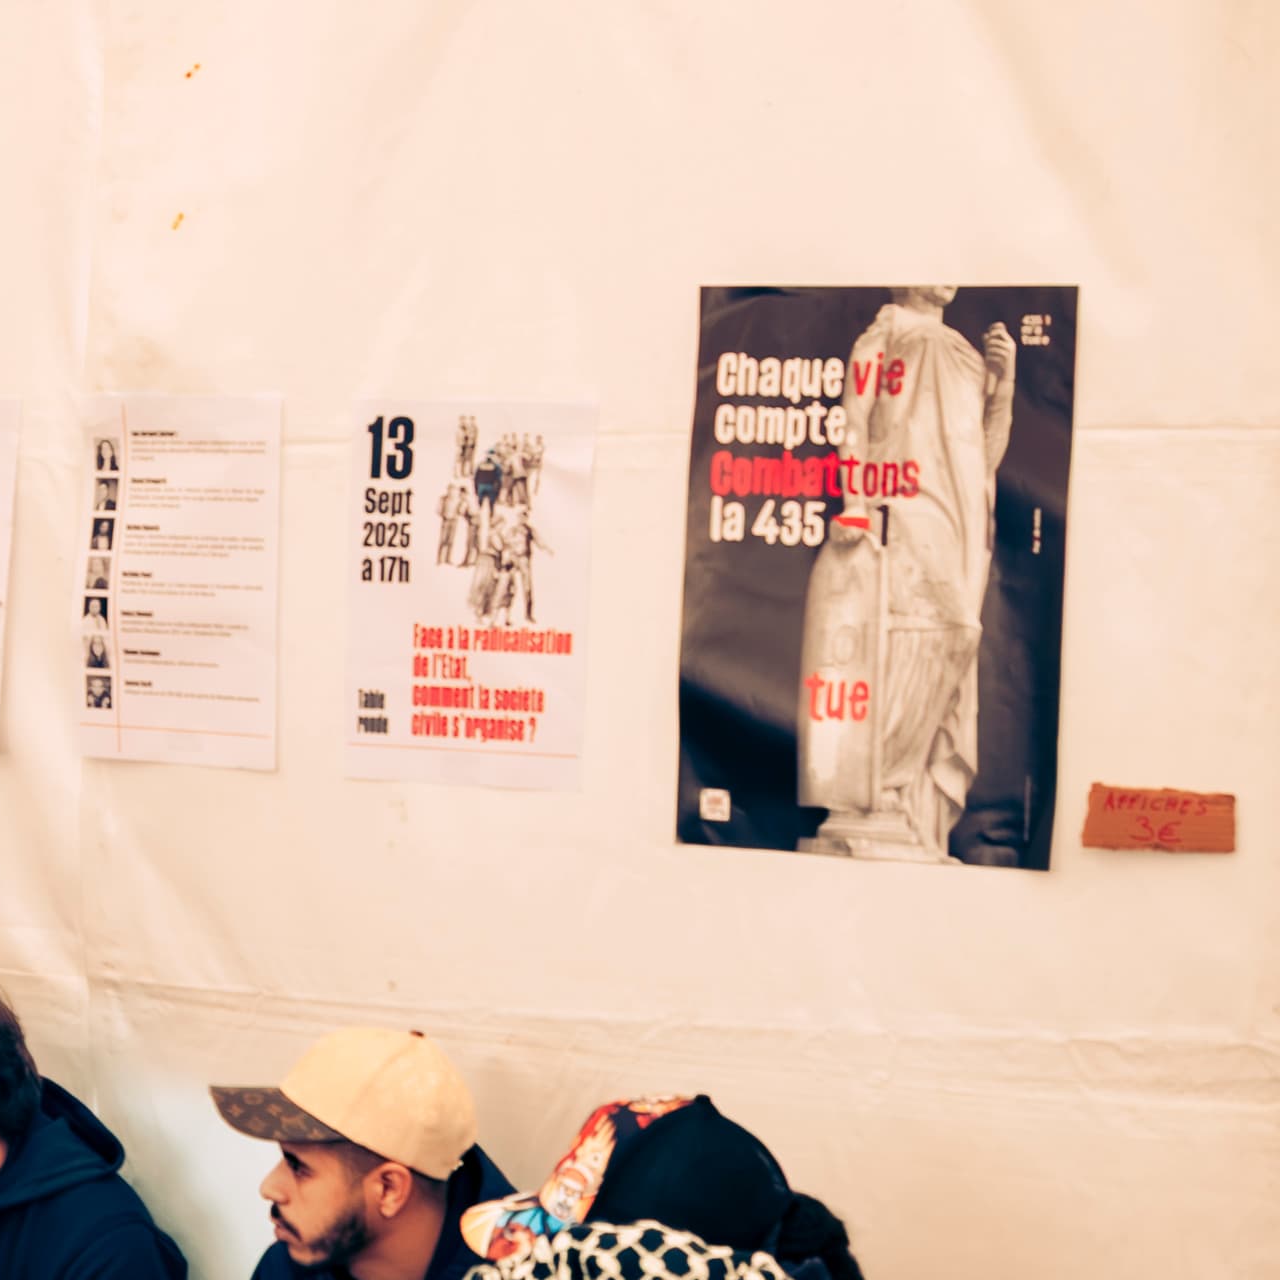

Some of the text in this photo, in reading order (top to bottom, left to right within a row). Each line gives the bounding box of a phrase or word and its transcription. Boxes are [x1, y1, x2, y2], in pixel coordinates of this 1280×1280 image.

[716, 351, 907, 403] Chaque vie
[714, 402, 858, 448] compte.
[367, 416, 415, 480] 13
[710, 451, 921, 498] Combattons
[364, 487, 413, 516] Sept
[363, 522, 410, 548] 2025
[710, 497, 745, 543] la
[379, 556, 410, 583] 17h
[414, 623, 443, 649] Face
[459, 625, 469, 650] la
[474, 626, 573, 655] radicalisation
[413, 653, 428, 678] de
[413, 684, 474, 709] comment
[479, 684, 489, 710] la
[804, 674, 870, 722] tue
[412, 711, 536, 743] civile s'organise ?
[1104, 792, 1209, 816] AFFICHES
[1129, 816, 1183, 843] 3€
